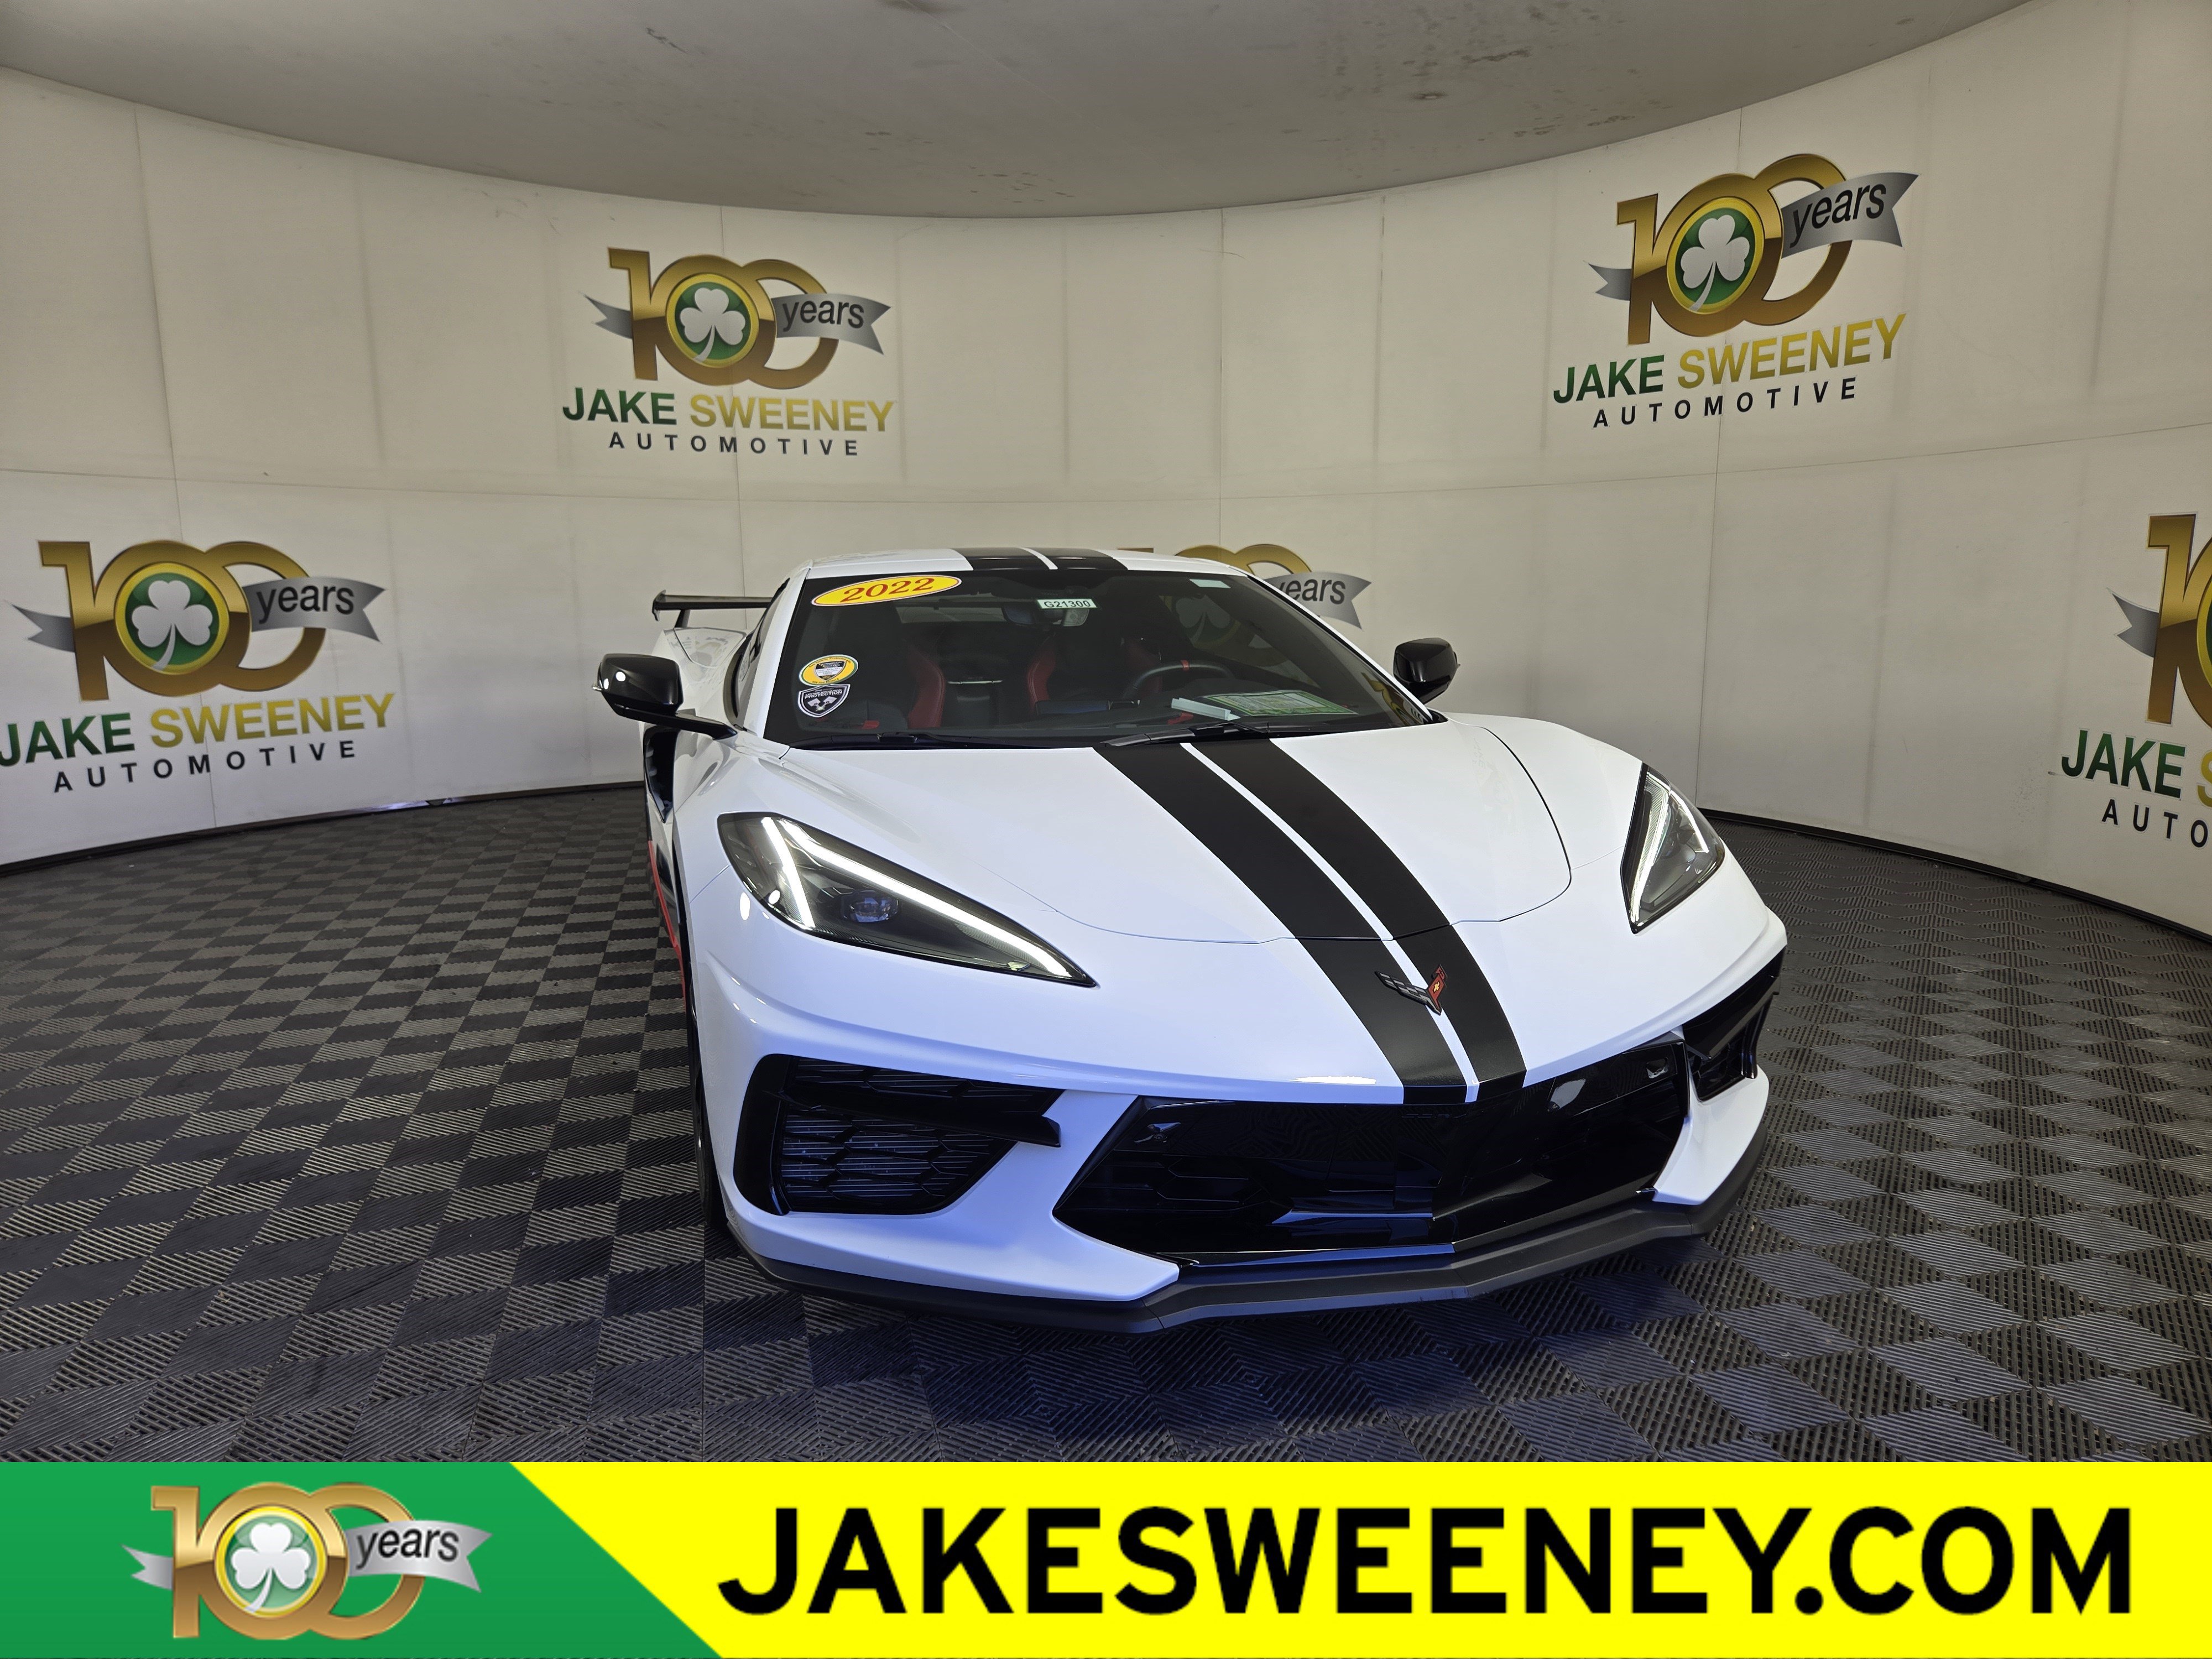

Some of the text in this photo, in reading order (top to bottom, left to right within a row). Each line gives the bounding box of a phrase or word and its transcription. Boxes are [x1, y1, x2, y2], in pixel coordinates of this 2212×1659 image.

[1789, 183, 1886, 249] years
[1617, 153, 1852, 345] 100
[608, 247, 839, 389] 100
[782, 299, 865, 332] years
[1553, 313, 1907, 404] JAKE SWEENEY
[562, 387, 894, 432] JAKE SWEENEY
[1593, 377, 1857, 429] AUTOMOTIVE
[609, 431, 858, 456] AUTOMOTIVE
[255, 582, 354, 625] years
[840, 577, 933, 603] 2022
[1279, 578, 1346, 605] ears
[38, 540, 326, 702] 100
[805, 690, 842, 699] PROTECTION
[0, 693, 395, 766] JAKE SWEENEY
[54, 740, 356, 792] AUTOMOTIVE
[2061, 729, 2186, 799] JAKE
[2101, 799, 2209, 848] AUTO
